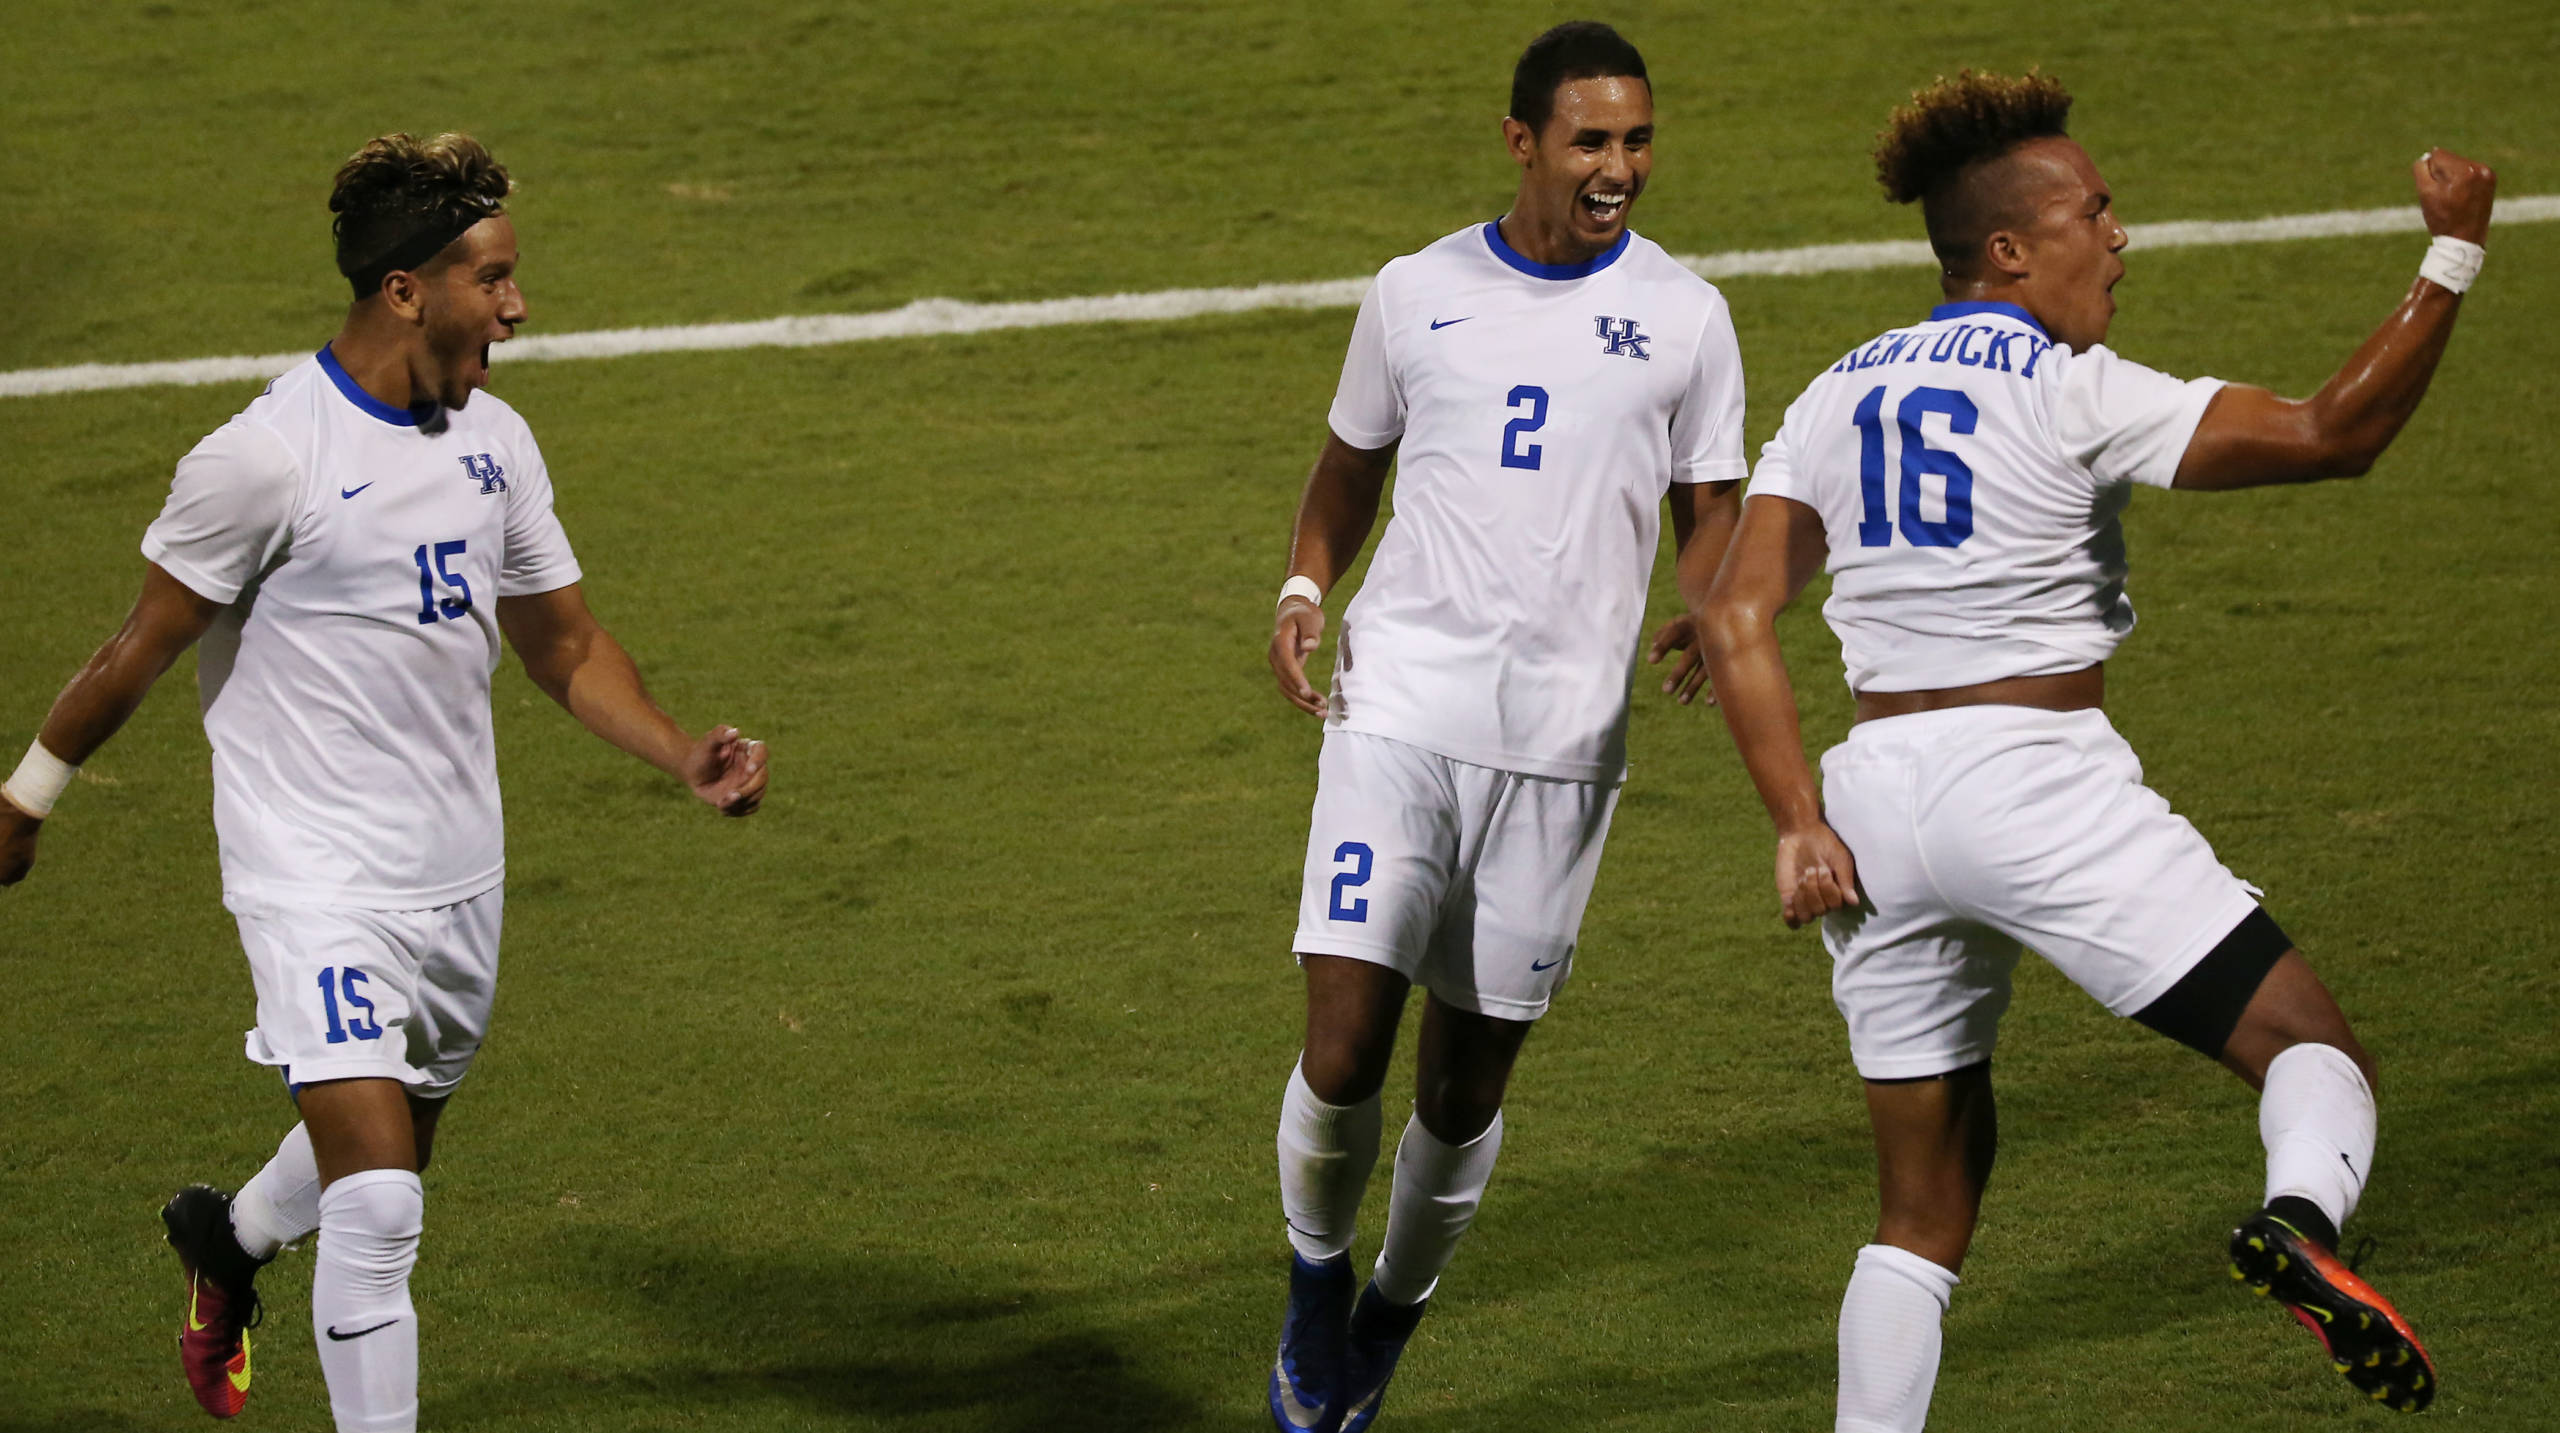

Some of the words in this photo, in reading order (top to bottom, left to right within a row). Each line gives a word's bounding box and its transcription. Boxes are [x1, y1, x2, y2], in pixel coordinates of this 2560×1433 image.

[1594, 315, 1650, 361] UK
[1501, 384, 1549, 471] 2
[1853, 385, 1978, 548] 16
[458, 453, 506, 495] UK
[414, 539, 472, 624] 15
[1328, 841, 1373, 923] 2
[317, 966, 383, 1044] 15
